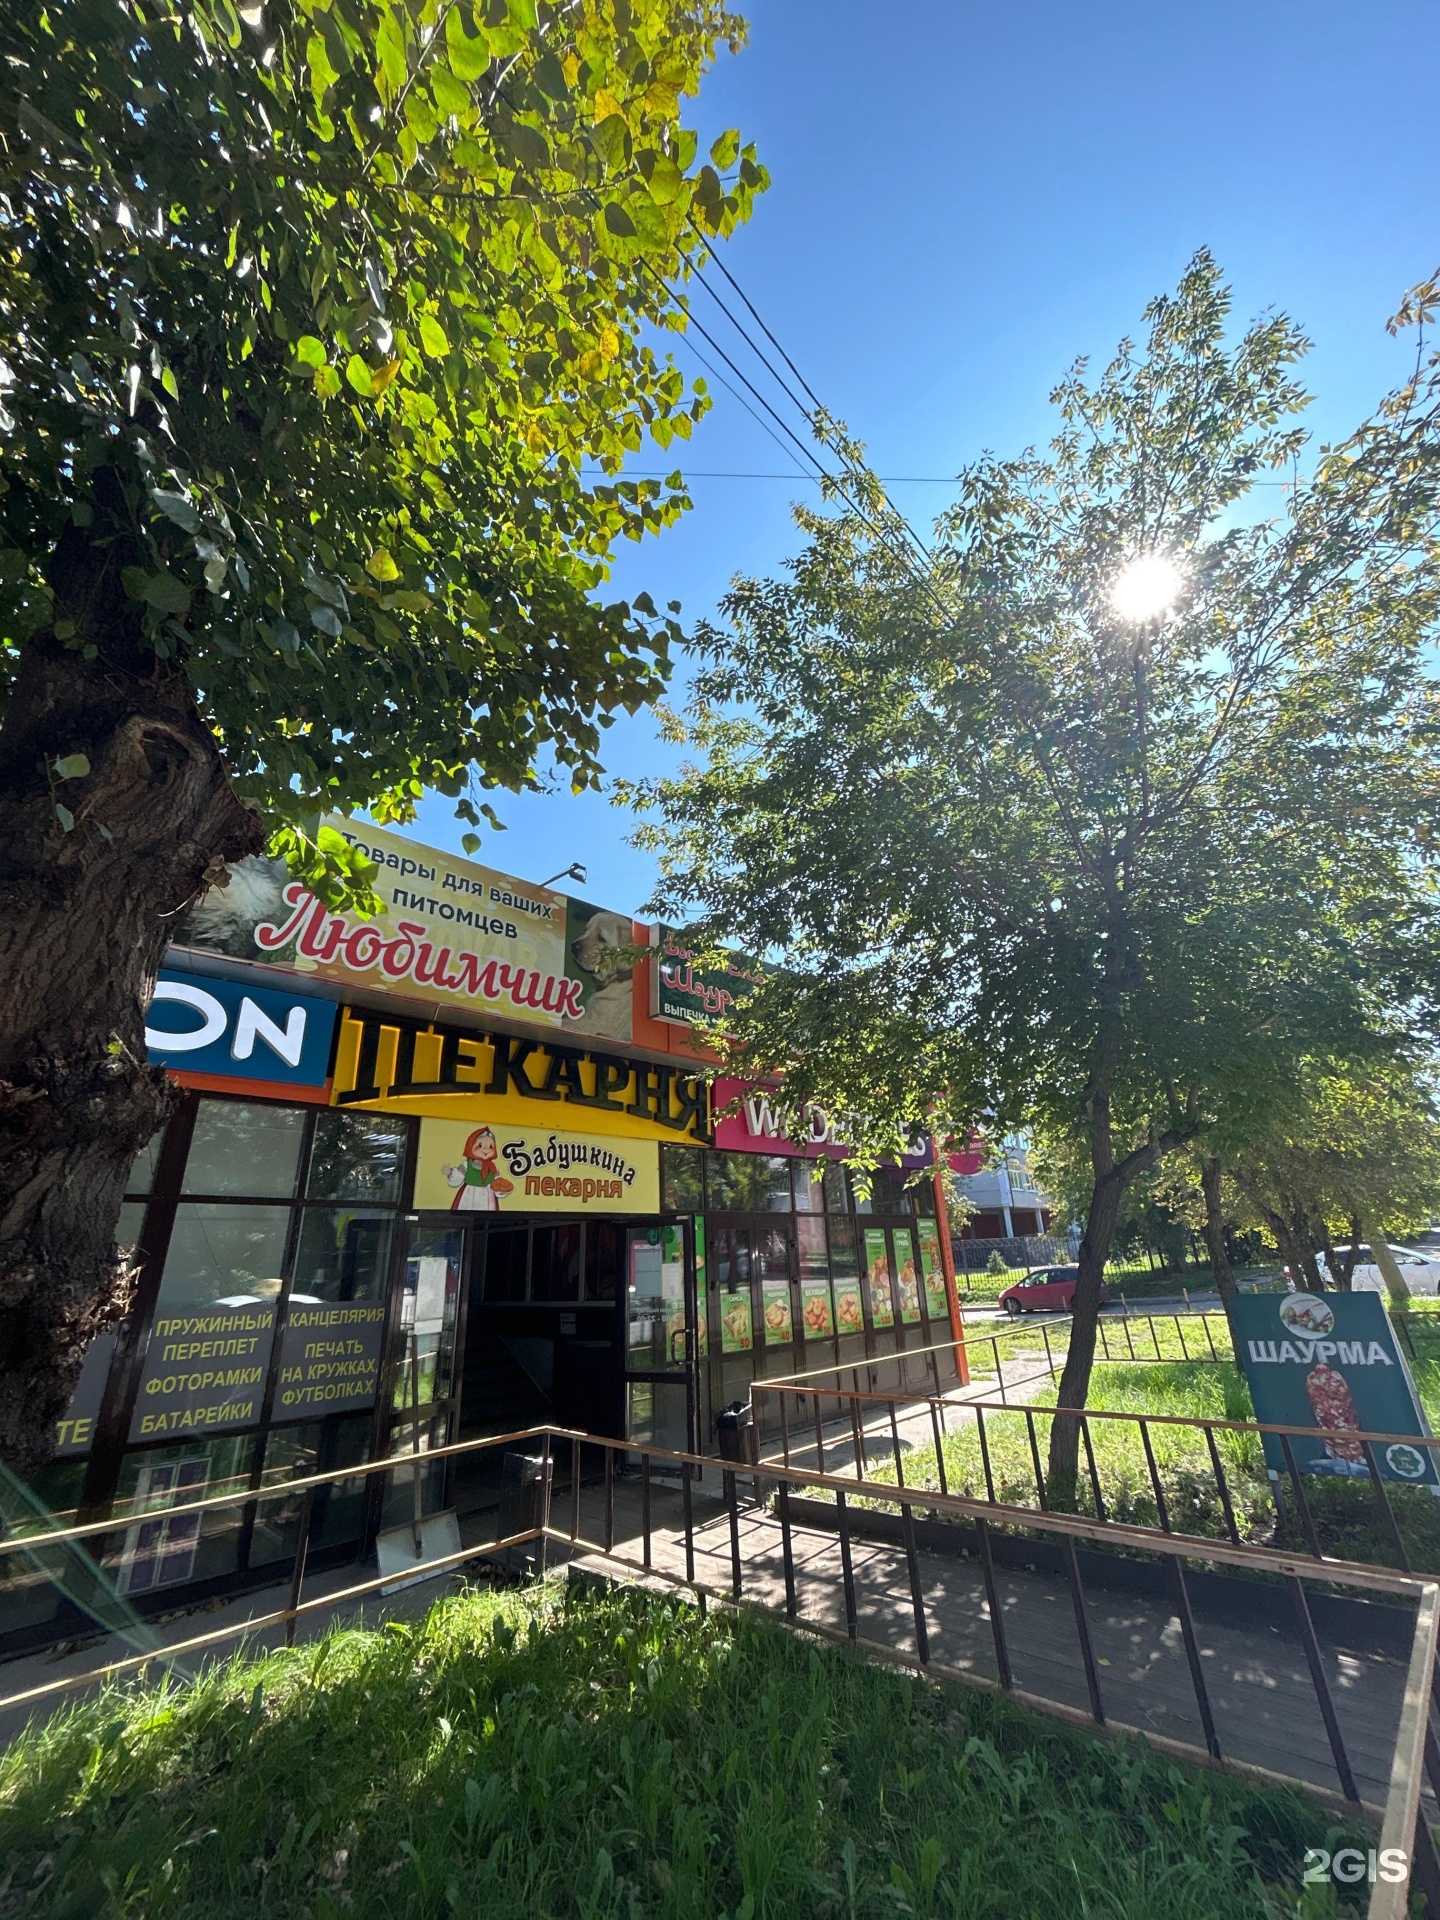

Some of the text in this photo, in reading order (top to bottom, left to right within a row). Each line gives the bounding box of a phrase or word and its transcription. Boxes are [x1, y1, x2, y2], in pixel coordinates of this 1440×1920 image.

[341, 831, 552, 920] Товары для ваших
[392, 888, 518, 939] питомцев
[256, 883, 585, 1018] Любимчик
[337, 1006, 714, 1146] ПЕКАРНЯ
[502, 1135, 636, 1185] Бабушкина
[525, 1175, 623, 1203] пекарня
[155, 1310, 273, 1337] ПРУЖИННЫЙ
[289, 1307, 385, 1328] КАНЦЕЛЯРИЯ
[162, 1337, 259, 1361] ПЕРЕПЛЕТ
[305, 1339, 364, 1360] ПЕЧАТЬ
[1248, 1340, 1394, 1366] ШАУРМА
[146, 1366, 263, 1395] ФОТОРАМКИ
[281, 1367, 303, 1384] НА
[281, 1379, 375, 1406] ФУТБОЛКАХ
[140, 1401, 254, 1434] БАТАРЕЙКИ
